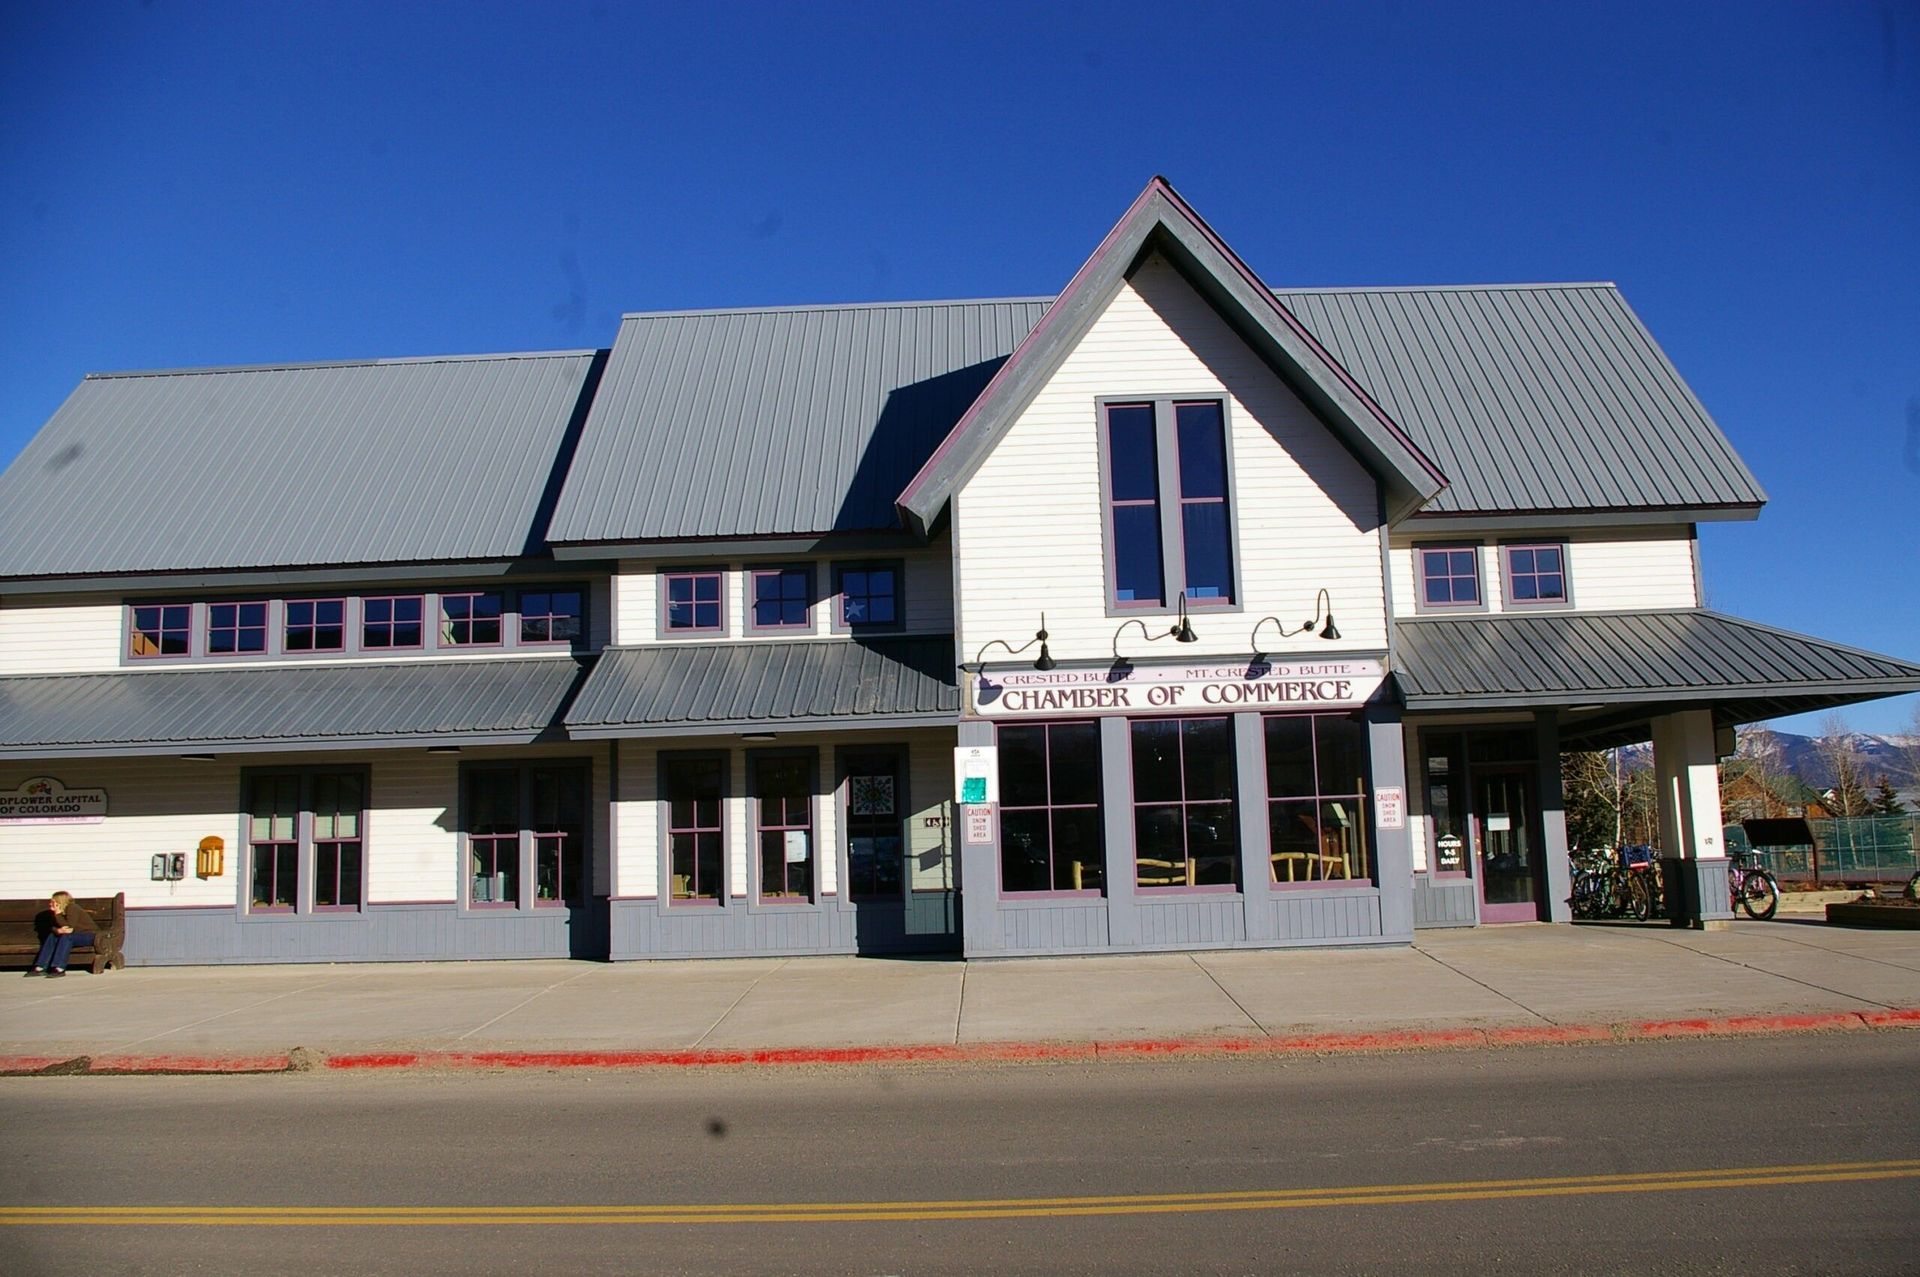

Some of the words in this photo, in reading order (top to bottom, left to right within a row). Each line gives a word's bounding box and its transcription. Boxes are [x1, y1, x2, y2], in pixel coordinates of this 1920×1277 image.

[1003, 673, 1079, 685] CRESTED
[1084, 671, 1136, 683] BUTTE
[1299, 665, 1351, 675] BUTTE
[1002, 688, 1131, 711] CHAMBER
[1148, 685, 1185, 706] OF
[1202, 680, 1353, 704] COMMERCE
[56, 795, 101, 804] CAPITAL
[1376, 793, 1400, 801] CAUTION
[0, 806, 15, 814] OF
[19, 804, 81, 814] COLORADO
[967, 808, 992, 816] CAUTION
[1437, 840, 1461, 848] HOURS
[1440, 857, 1460, 865] DAILY
